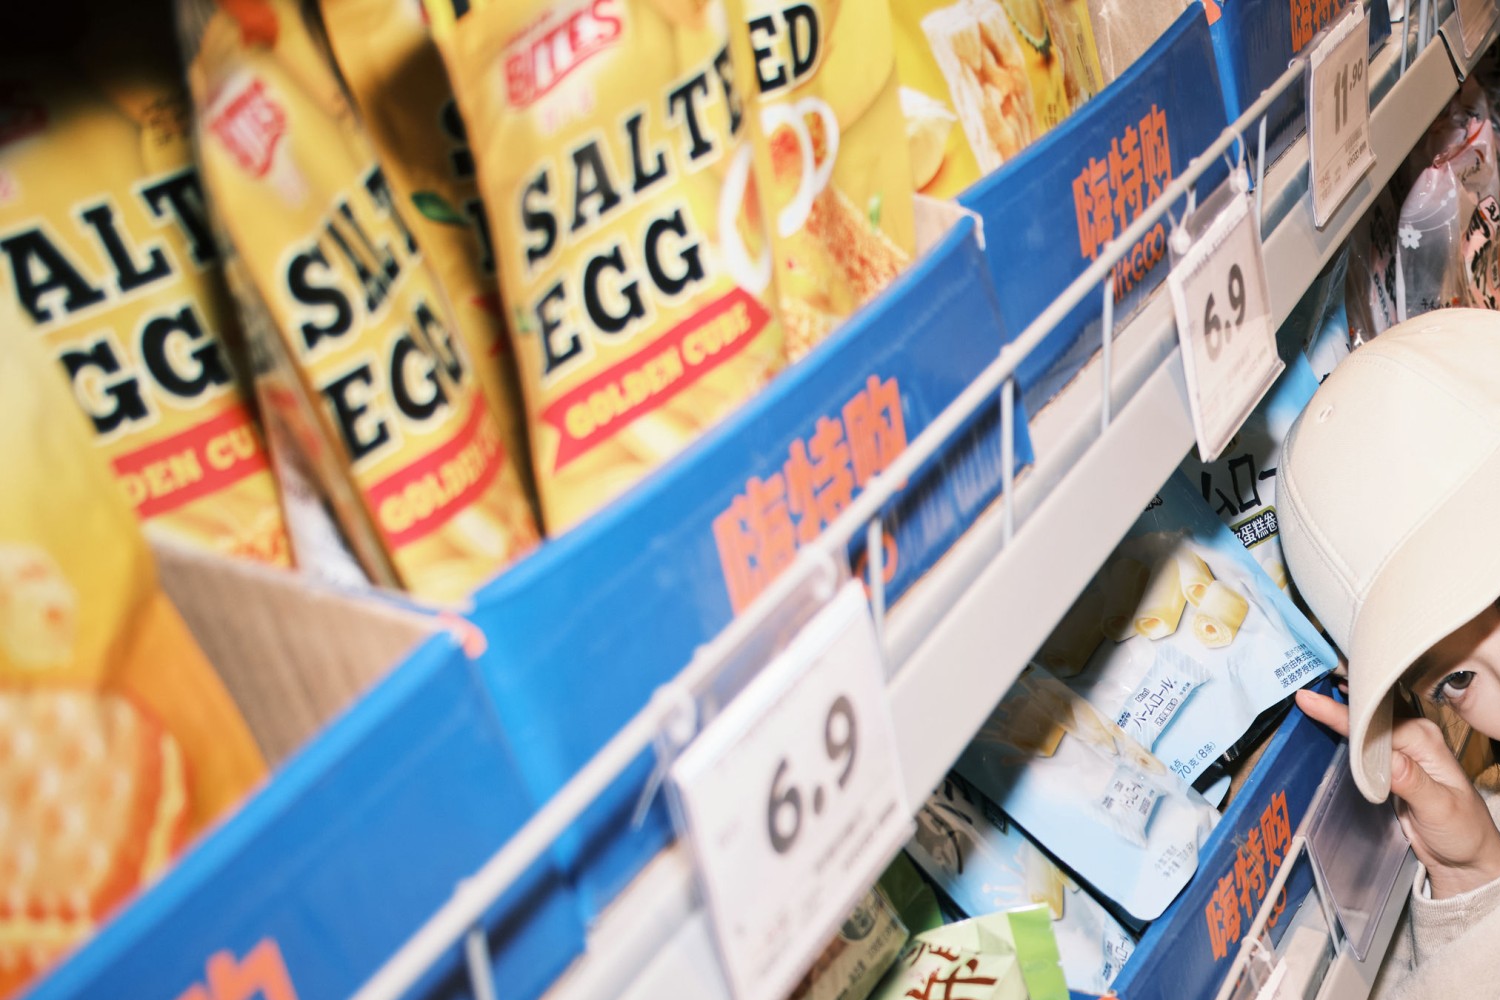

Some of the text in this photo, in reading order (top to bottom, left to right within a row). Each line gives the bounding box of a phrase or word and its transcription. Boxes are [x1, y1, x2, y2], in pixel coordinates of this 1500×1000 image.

[748, 4, 819, 93] ED
[1333, 57, 1363, 136] 11.90
[1072, 103, 1172, 262] 嗨特购
[533, 208, 702, 378] EGG
[566, 303, 753, 433] GOLDEN CUBE
[1203, 263, 1246, 362] 6.9
[712, 374, 908, 622] 嗨特购
[767, 696, 858, 856] 6.9
[1205, 790, 1293, 961] 嗨特购
